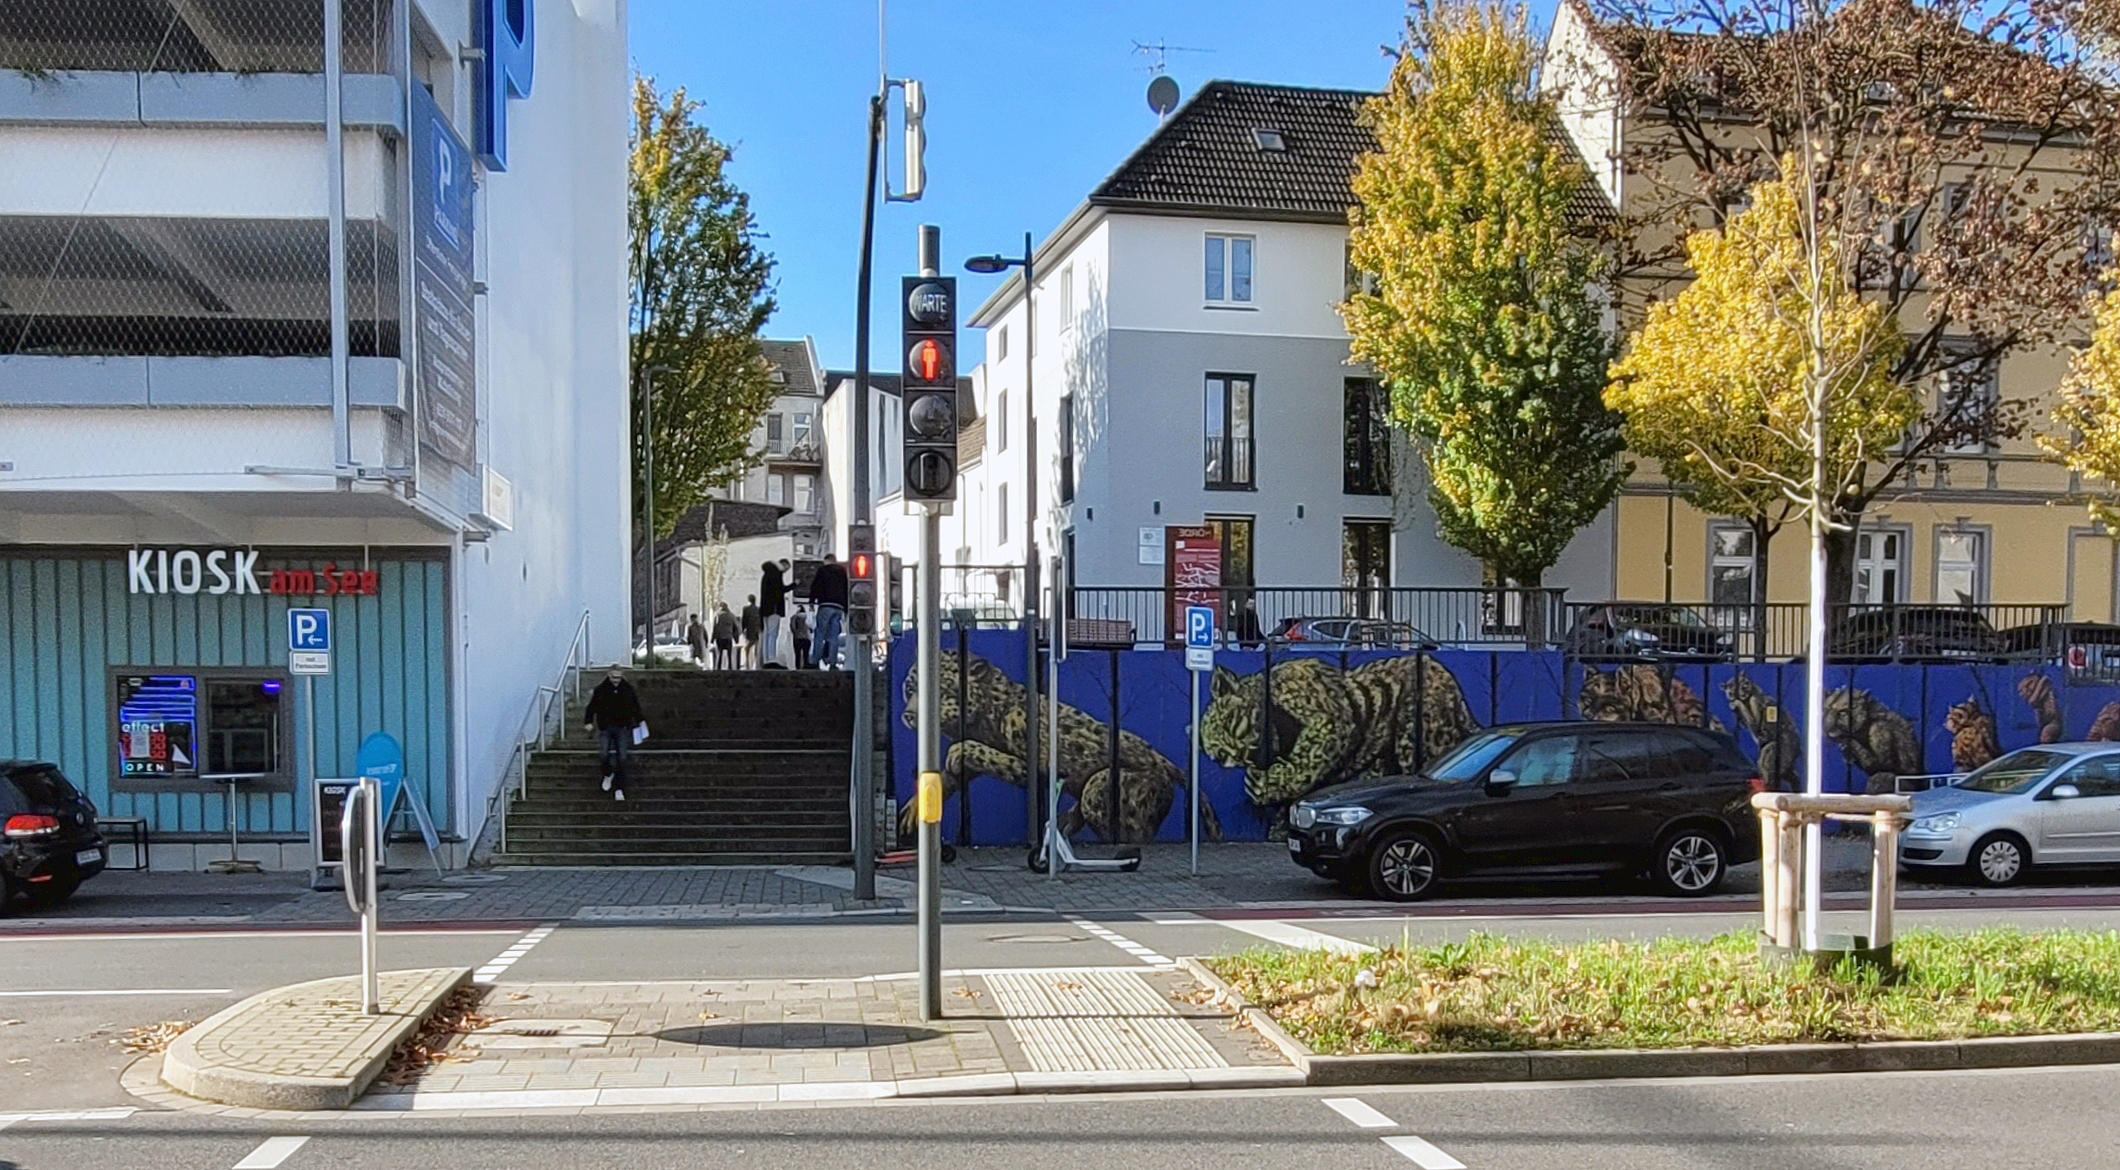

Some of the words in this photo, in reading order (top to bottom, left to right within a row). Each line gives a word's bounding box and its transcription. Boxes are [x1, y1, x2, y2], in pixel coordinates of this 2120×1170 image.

[912, 293, 948, 313] WARTE
[128, 549, 261, 594] KIOSK
[269, 569, 314, 595] am
[321, 562, 378, 596] See
[296, 614, 318, 646] P
[1191, 612, 1206, 642] P
[125, 763, 165, 772] OPEN
